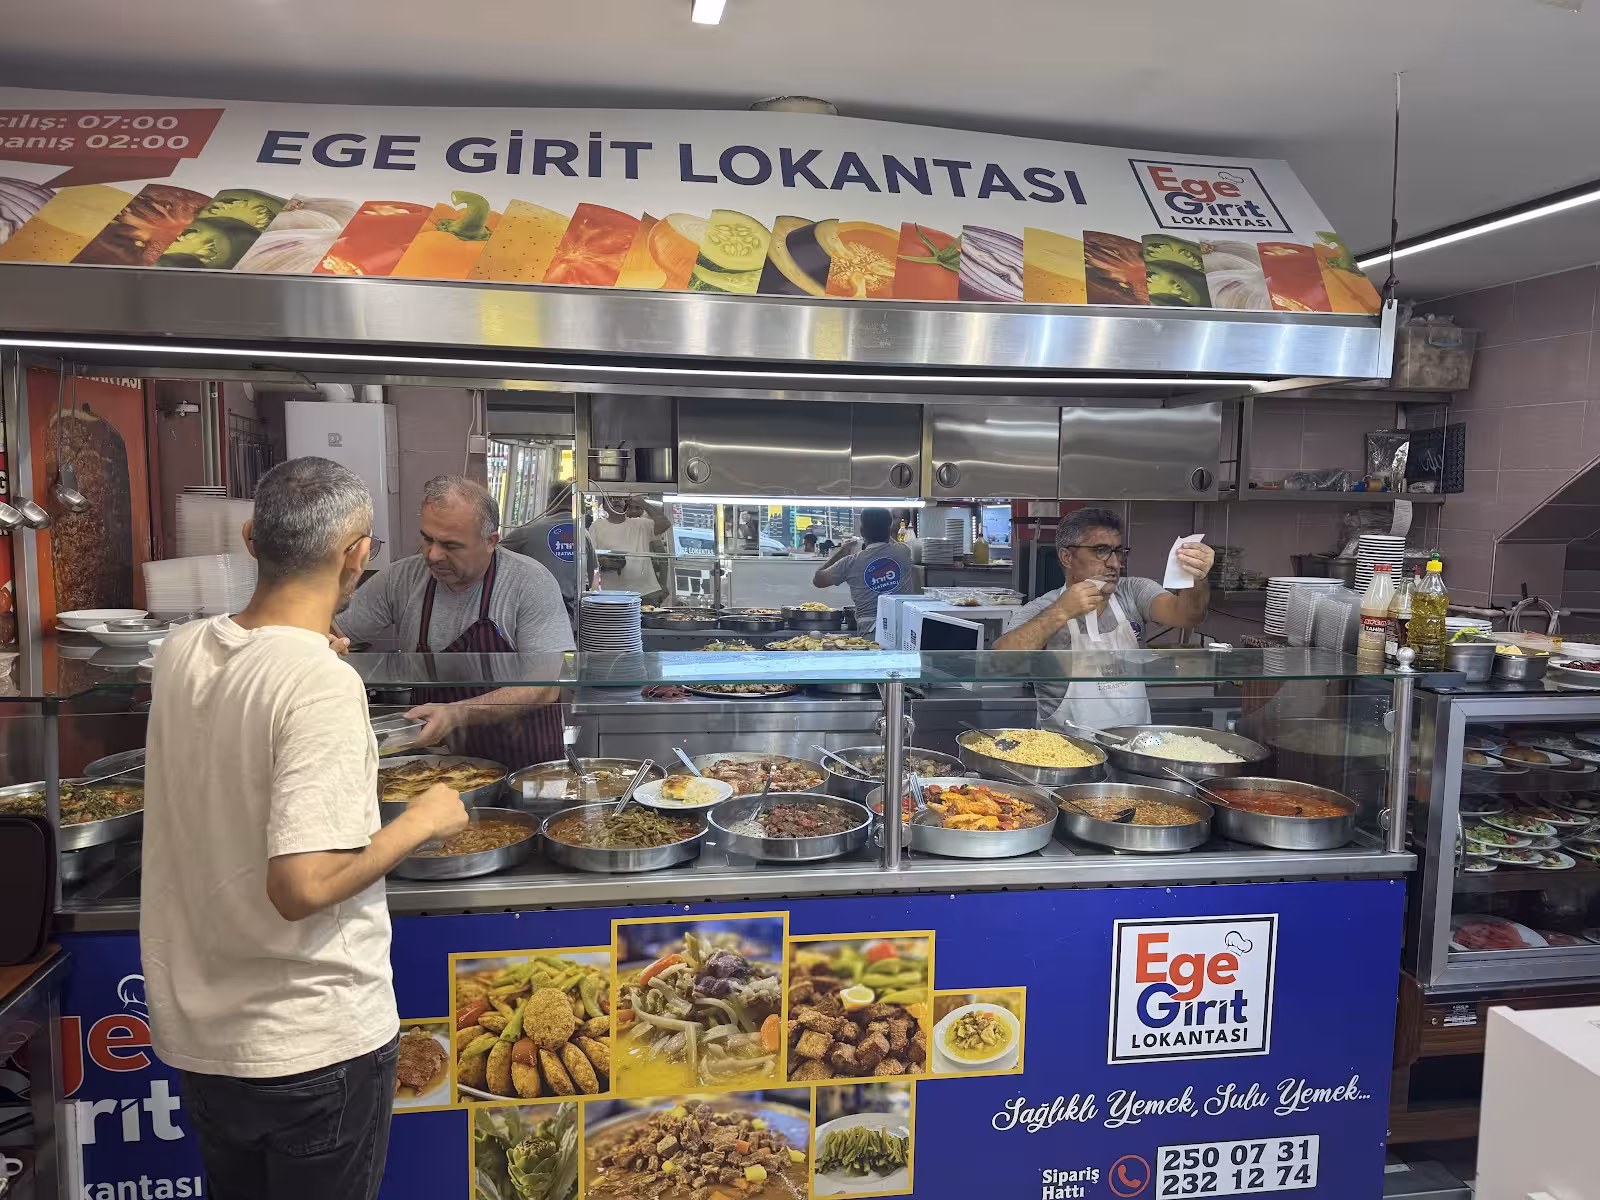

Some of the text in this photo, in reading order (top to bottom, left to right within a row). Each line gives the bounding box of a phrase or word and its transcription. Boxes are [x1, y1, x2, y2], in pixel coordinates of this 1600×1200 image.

[77, 115, 179, 130] 07:00
[85, 134, 190, 150] 02:00
[256, 129, 1088, 205] EGE GİRİT LOKANTASI
[1147, 166, 1242, 203] Ege
[1164, 192, 1267, 218] Girit
[1171, 215, 1273, 228] LOKANTASI
[1135, 932, 1239, 1002] Ege
[1137, 983, 1248, 1029] Girit
[1131, 1028, 1248, 1049] LOKANTASI
[991, 1093, 1099, 1134] Sağlıklı
[1103, 1086, 1199, 1129] Yemek,
[1204, 1082, 1271, 1116] Sulu
[1163, 1139, 1309, 1171] 250 07 31
[1042, 1166, 1100, 1186] Sipariş
[1161, 1163, 1311, 1196] 232 12 74
[1042, 1185, 1085, 1200] Hattı
